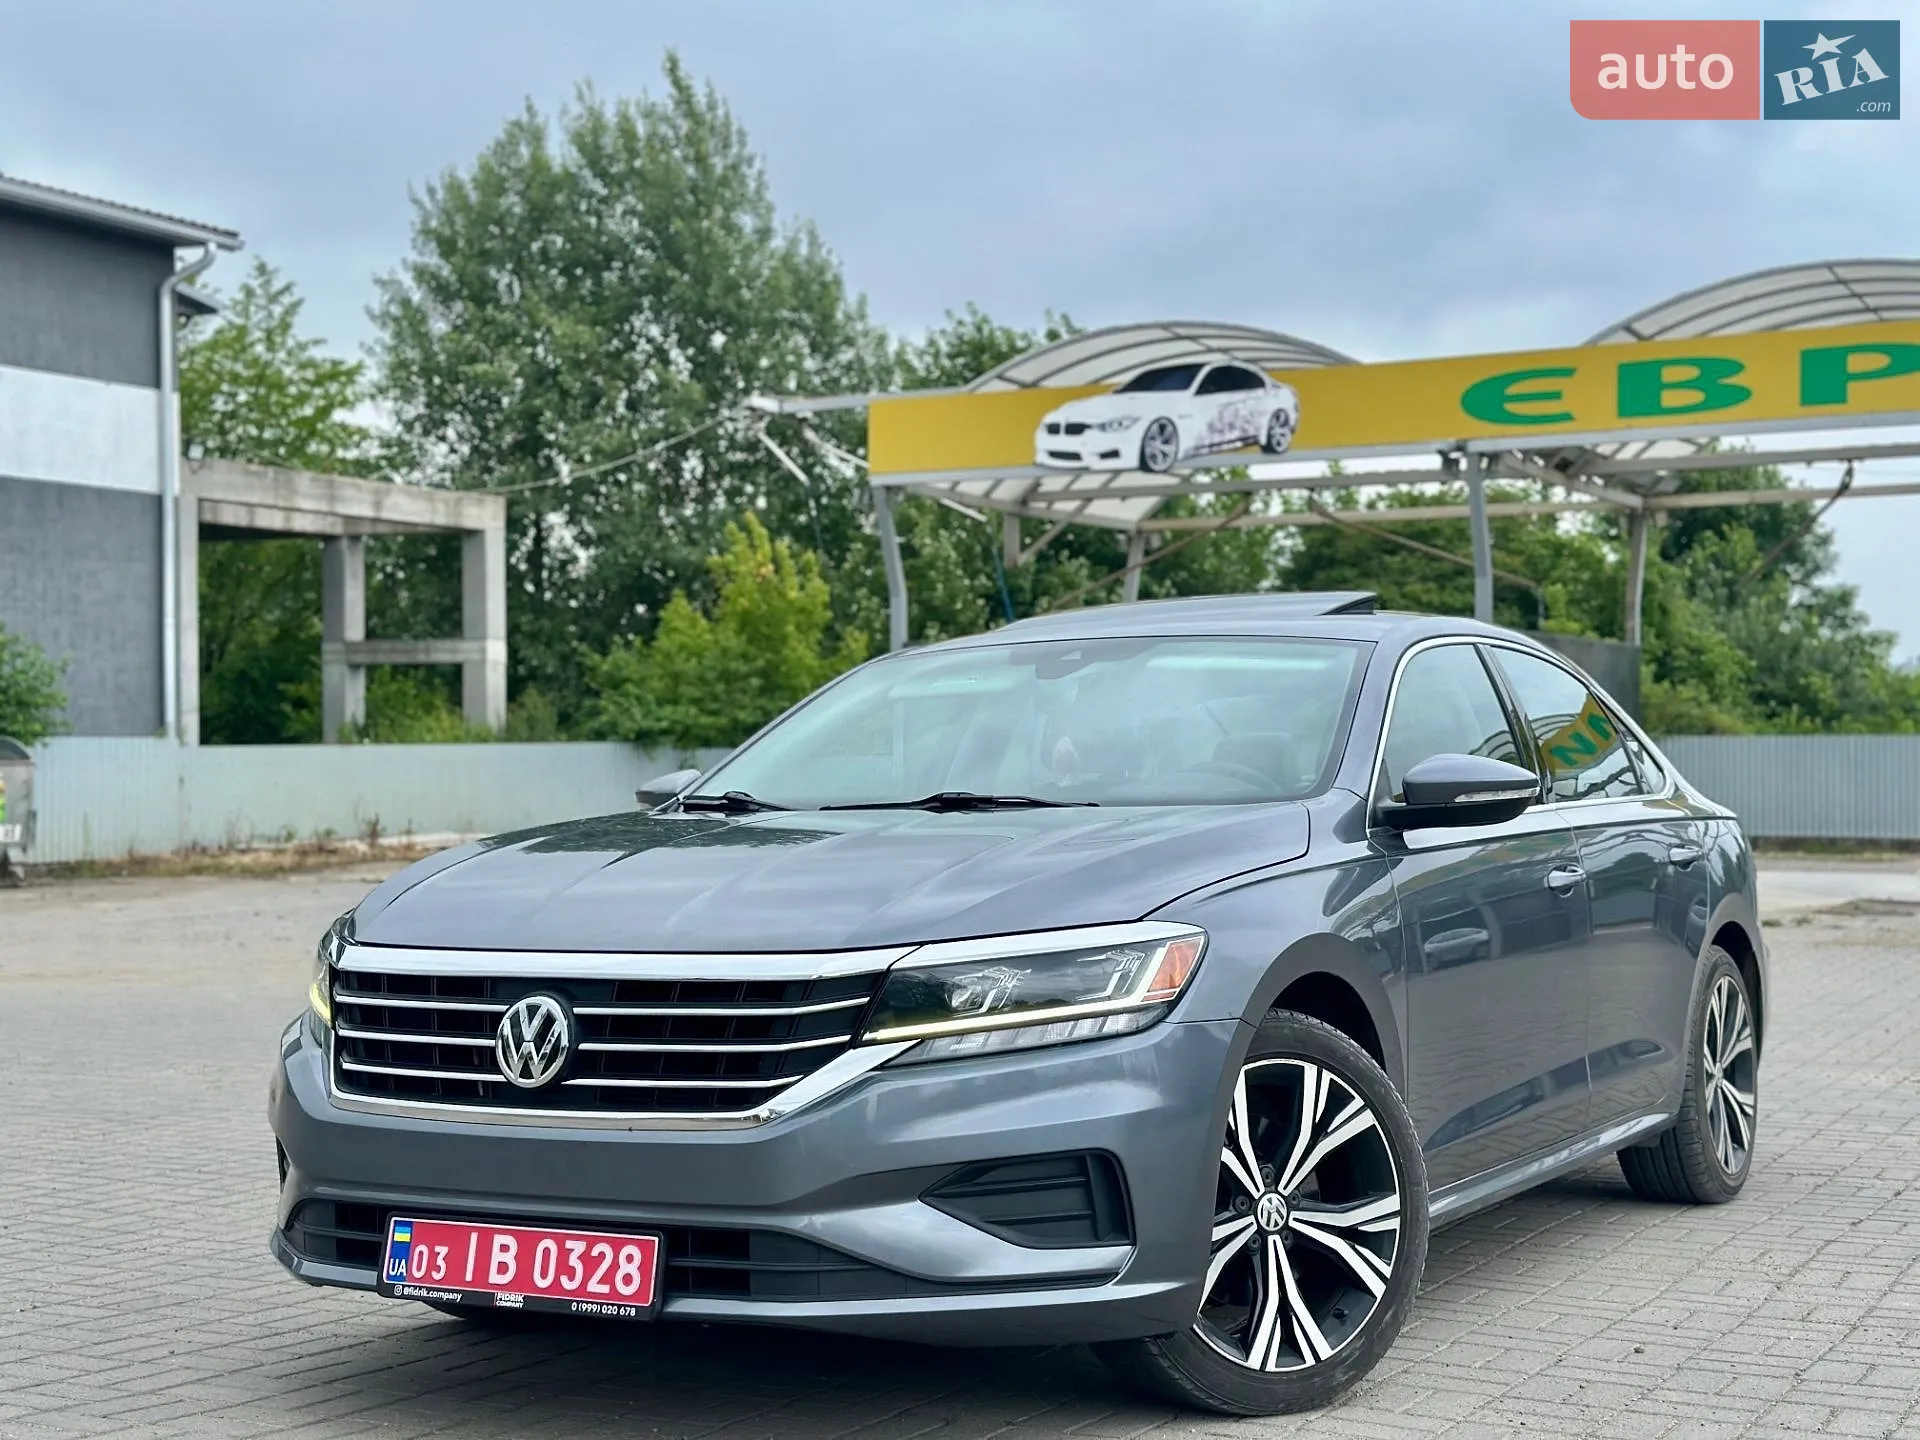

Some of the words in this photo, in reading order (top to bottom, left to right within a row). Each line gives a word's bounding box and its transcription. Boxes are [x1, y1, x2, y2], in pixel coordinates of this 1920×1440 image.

[388, 1258, 407, 1278] UA
[411, 1244, 449, 1281] 03
[533, 1238, 642, 1296] 0328
